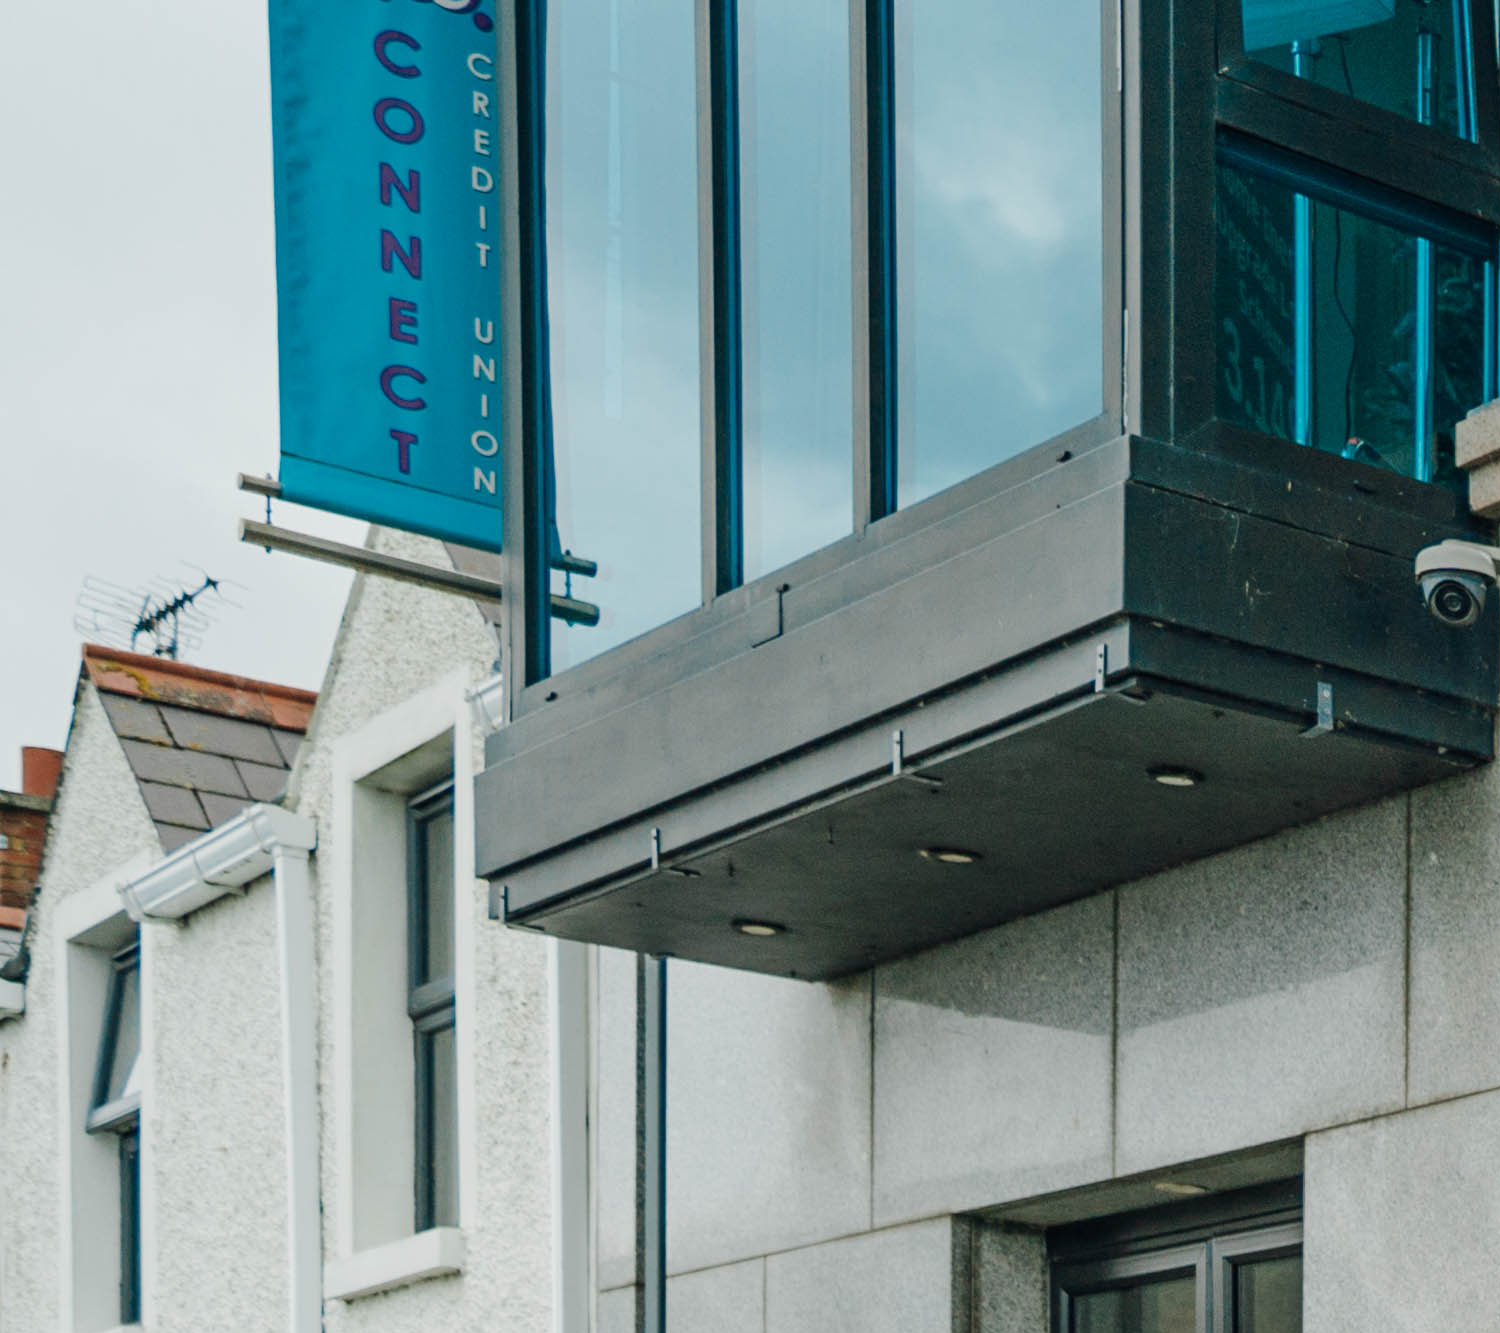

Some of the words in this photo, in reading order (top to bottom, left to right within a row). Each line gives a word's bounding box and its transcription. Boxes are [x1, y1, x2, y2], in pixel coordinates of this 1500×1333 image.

[373, 29, 428, 475] CONNECT
[467, 52, 494, 268] CREDIT
[471, 317, 498, 495] UNION
